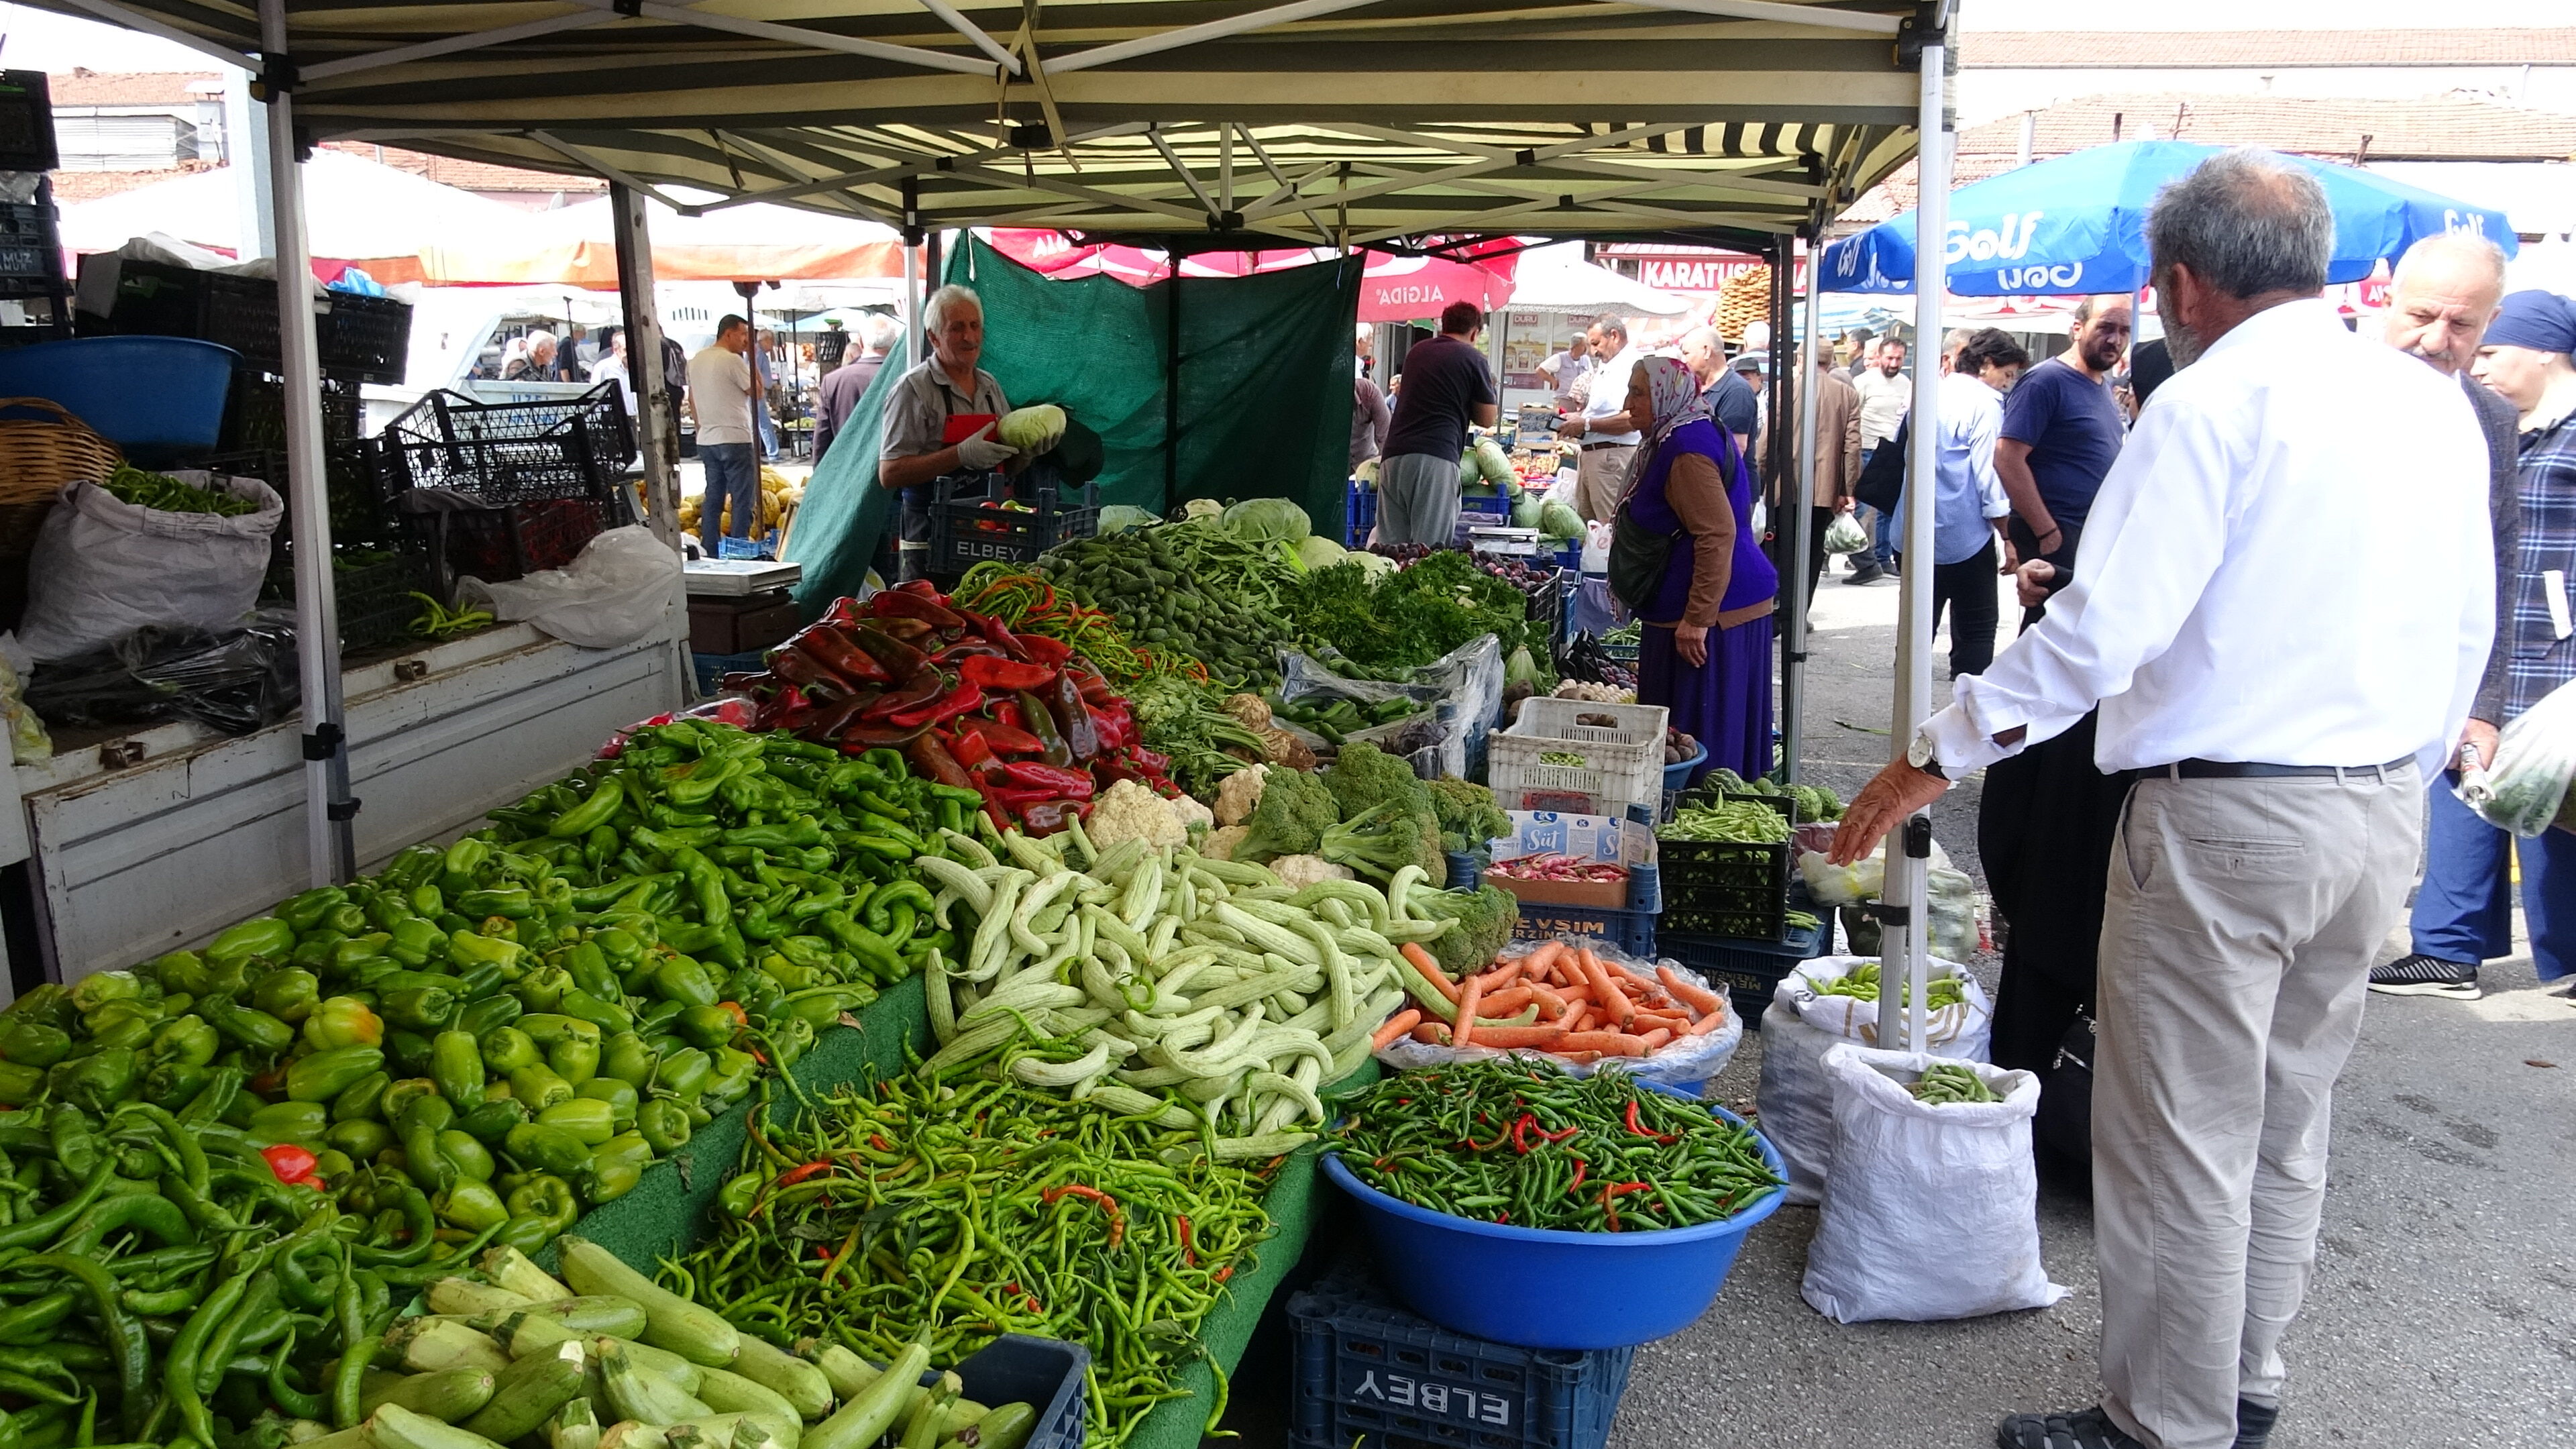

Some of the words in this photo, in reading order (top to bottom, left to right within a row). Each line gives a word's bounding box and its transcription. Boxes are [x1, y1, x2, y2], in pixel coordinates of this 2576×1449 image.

[1945, 211, 2044, 264] Golf
[957, 541, 1022, 561] ELBEY
[1527, 829, 1560, 850] Süt
[1354, 1370, 1509, 1425] ELBEY
